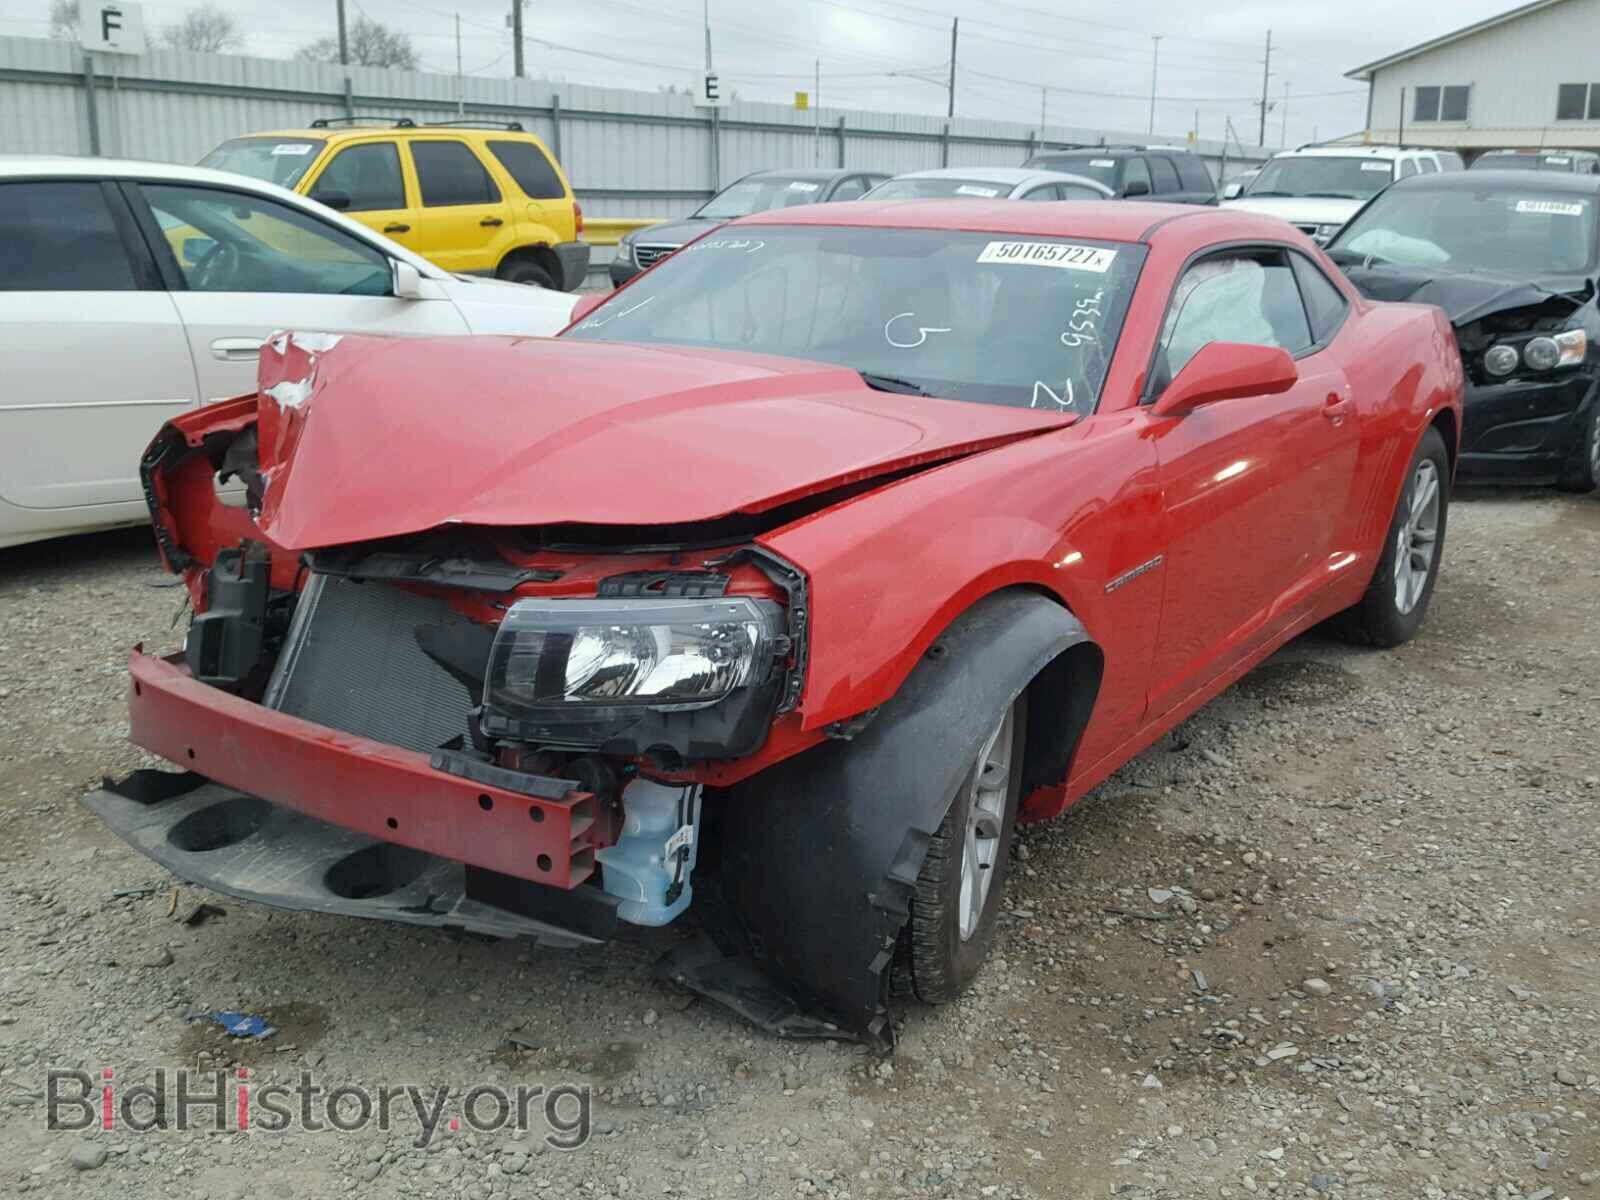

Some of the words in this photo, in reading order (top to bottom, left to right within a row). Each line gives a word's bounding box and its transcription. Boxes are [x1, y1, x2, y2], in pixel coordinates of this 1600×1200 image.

[101, 9, 122, 41] F
[705, 76, 720, 99] E
[996, 243, 1098, 265] 50165727
